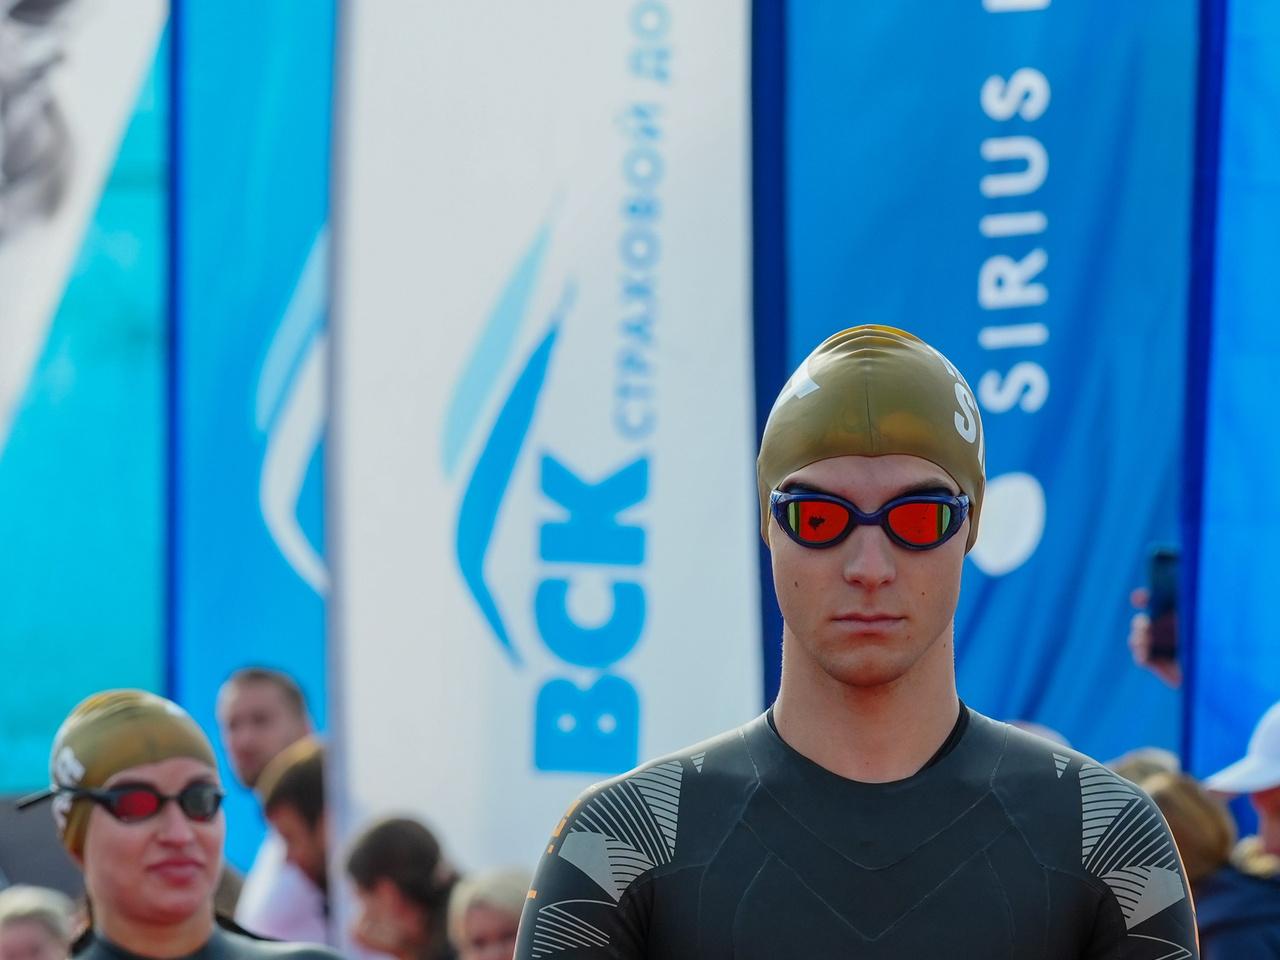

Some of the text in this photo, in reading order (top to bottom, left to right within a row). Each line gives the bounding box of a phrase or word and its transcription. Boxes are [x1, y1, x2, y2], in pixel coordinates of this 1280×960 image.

[613, 103, 664, 442] СТРАХОВОЙ
[978, 67, 1051, 413] SIRIUS
[535, 455, 648, 774] ВСК
